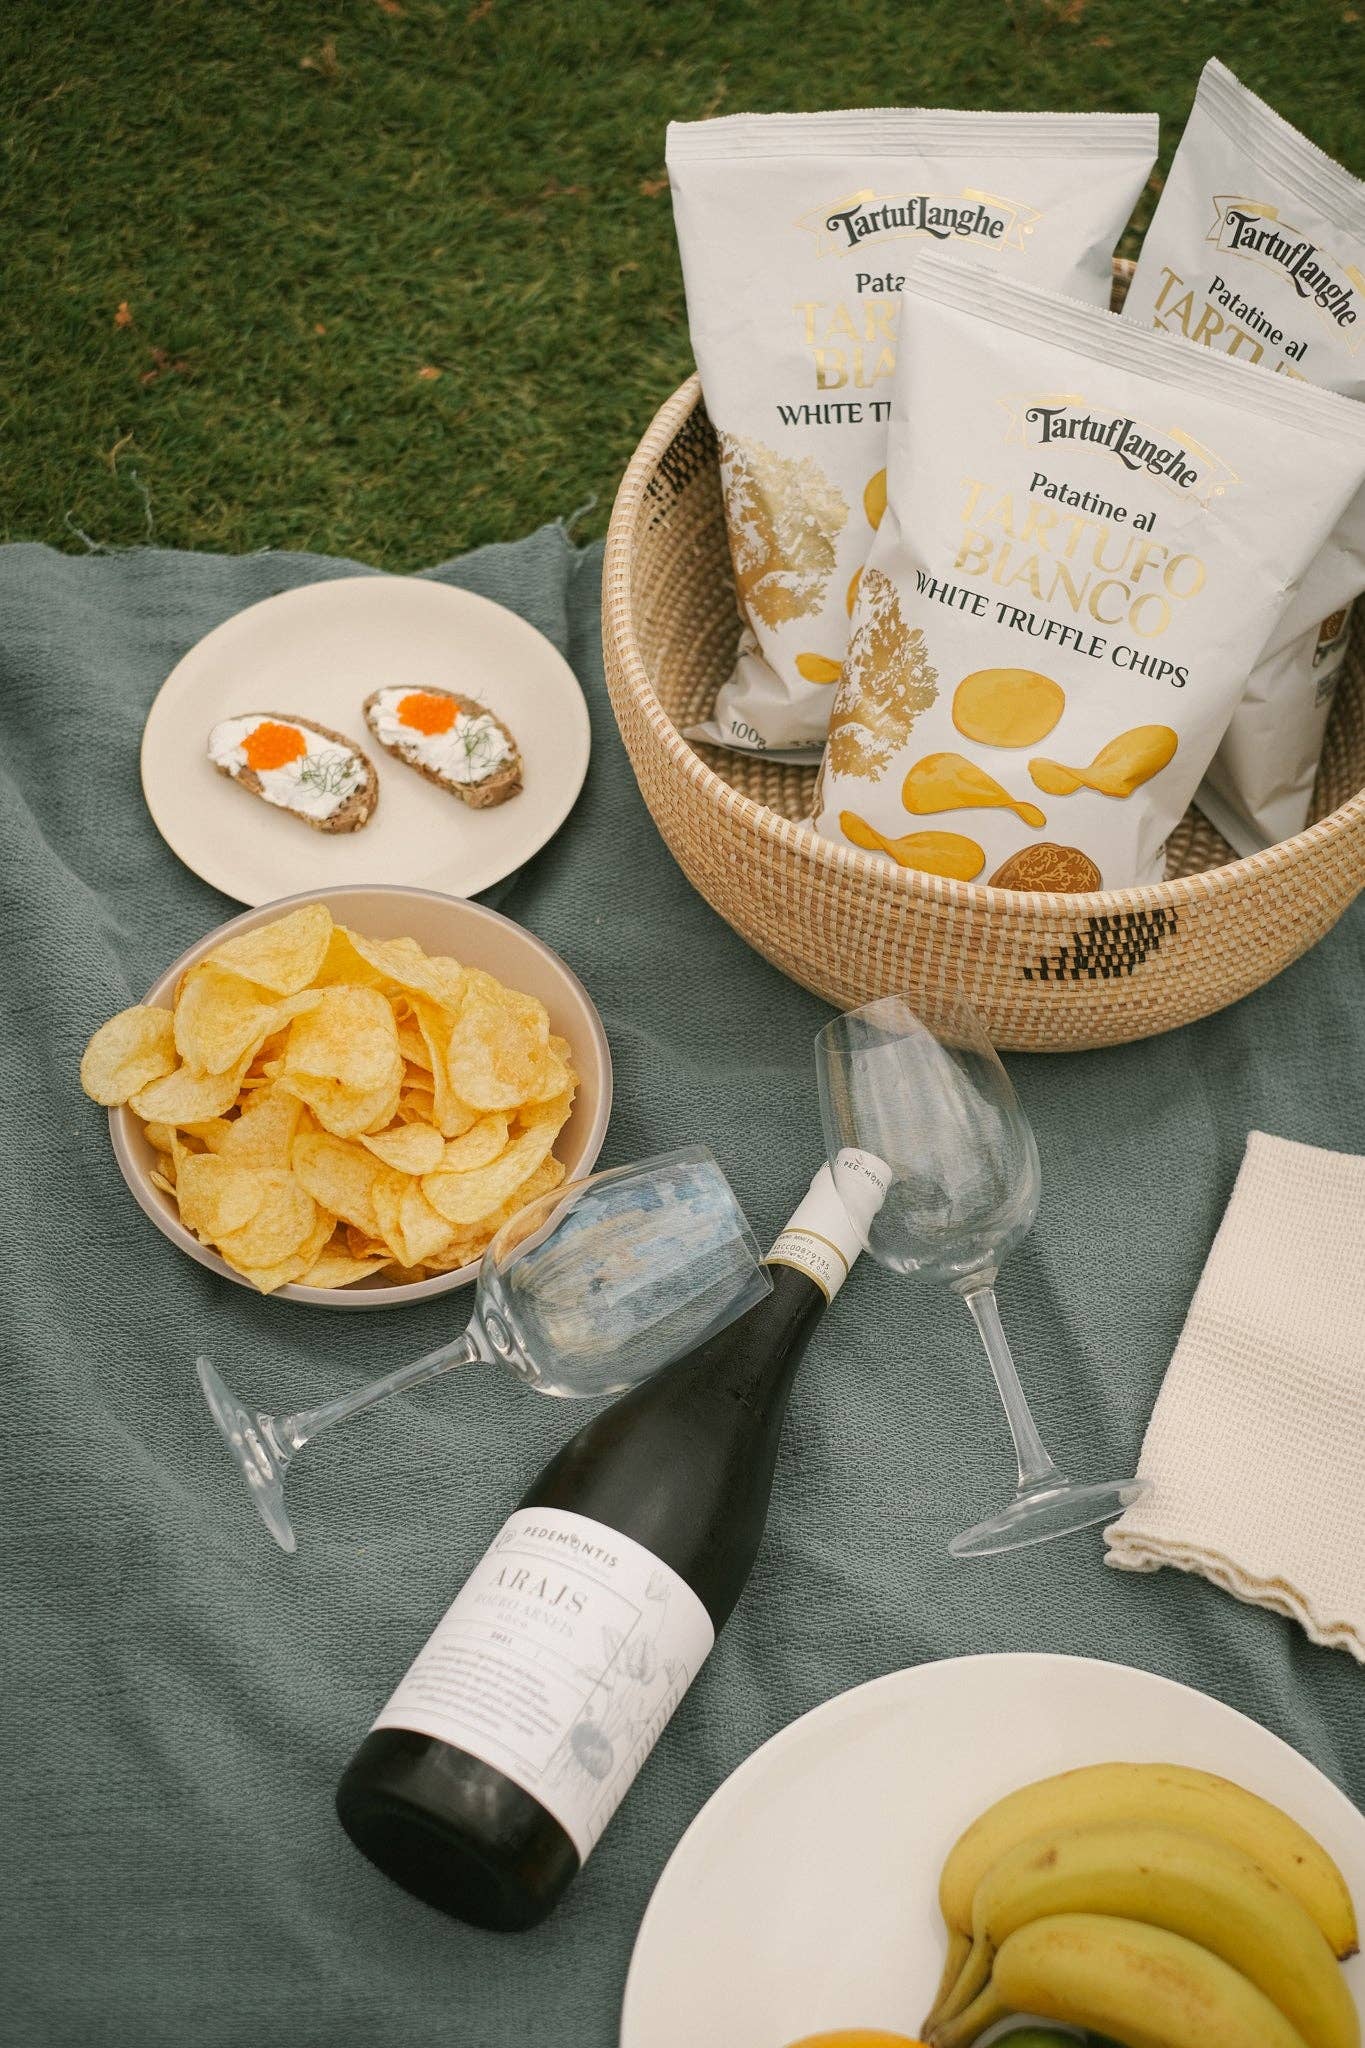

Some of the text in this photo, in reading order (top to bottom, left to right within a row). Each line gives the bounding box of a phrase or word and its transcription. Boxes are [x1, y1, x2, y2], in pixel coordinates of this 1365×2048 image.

[826, 196, 1004, 248] TartufLanghe
[1225, 211, 1357, 328] TartufLanghe
[792, 299, 903, 345] TAR
[1207, 275, 1308, 362] Patatine al
[776, 401, 891, 426] WHITE T
[1025, 407, 1198, 488] TartufLanghe
[1029, 472, 1157, 532] Patatine al
[959, 478, 1207, 600] TARTUFO
[954, 530, 1172, 638] BIANCO
[916, 569, 1190, 689] WHITE TRUFFLE CHIPS
[731, 720, 767, 751] 100g
[523, 1526, 619, 1568] PEDEMONTIS
